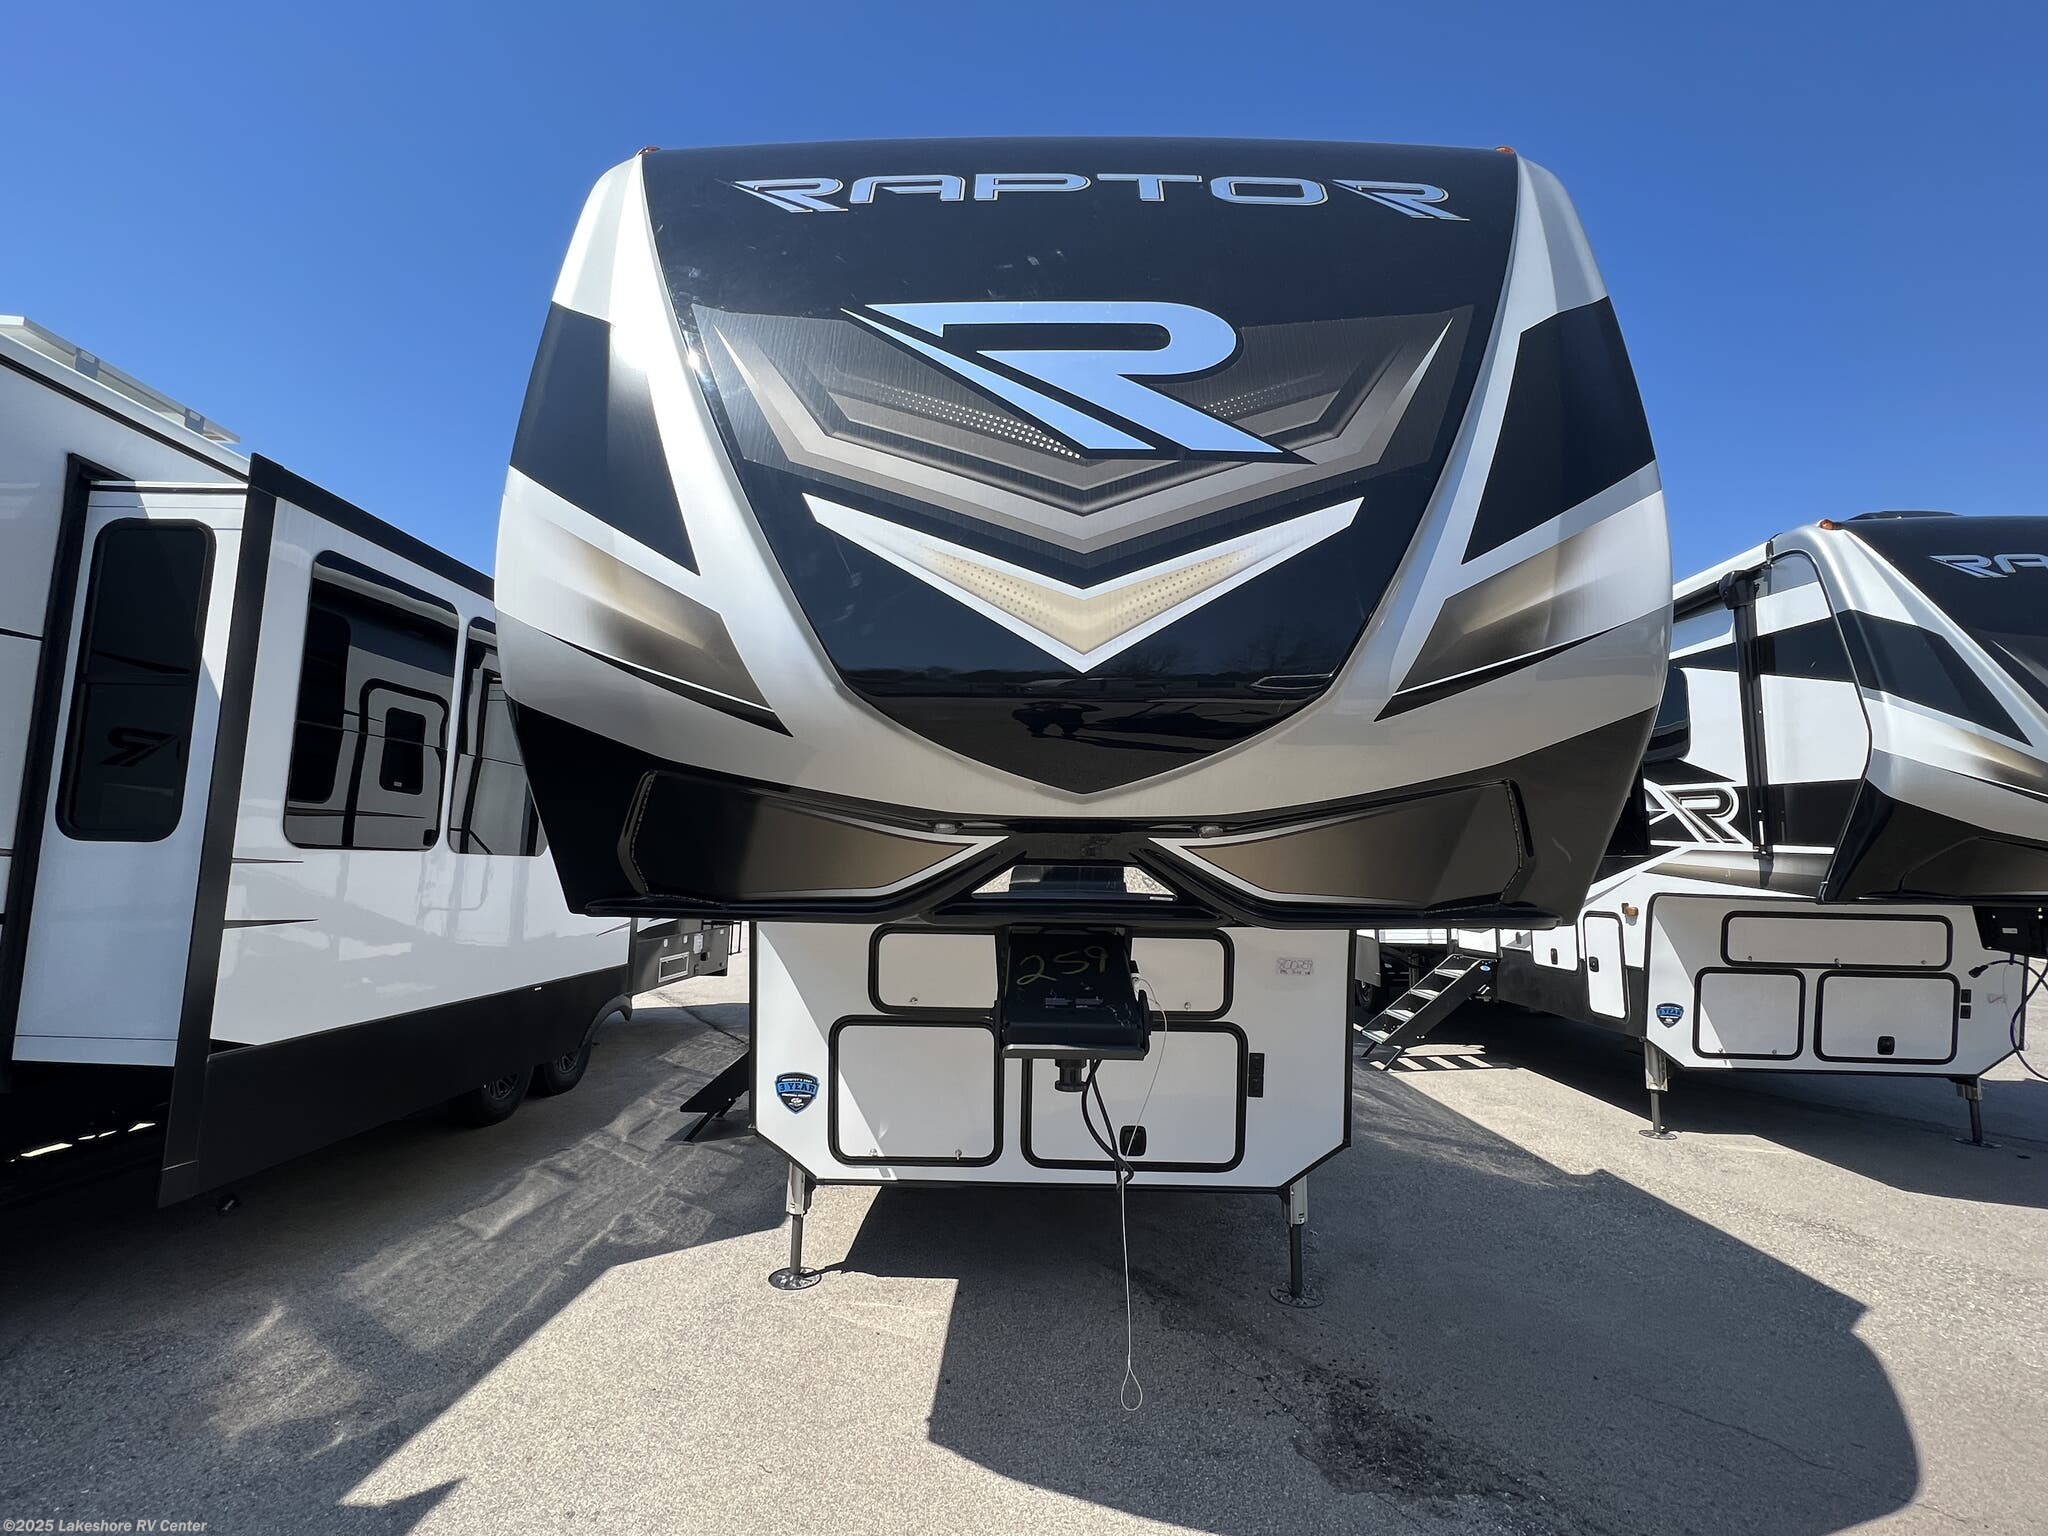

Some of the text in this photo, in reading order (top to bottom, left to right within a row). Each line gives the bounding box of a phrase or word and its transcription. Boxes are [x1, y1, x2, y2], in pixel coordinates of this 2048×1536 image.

[731, 173, 1470, 221] RAPTOR
[840, 301, 1290, 455] R
[1016, 946, 1108, 985] 259
[788, 1082, 815, 1092] YEAR
